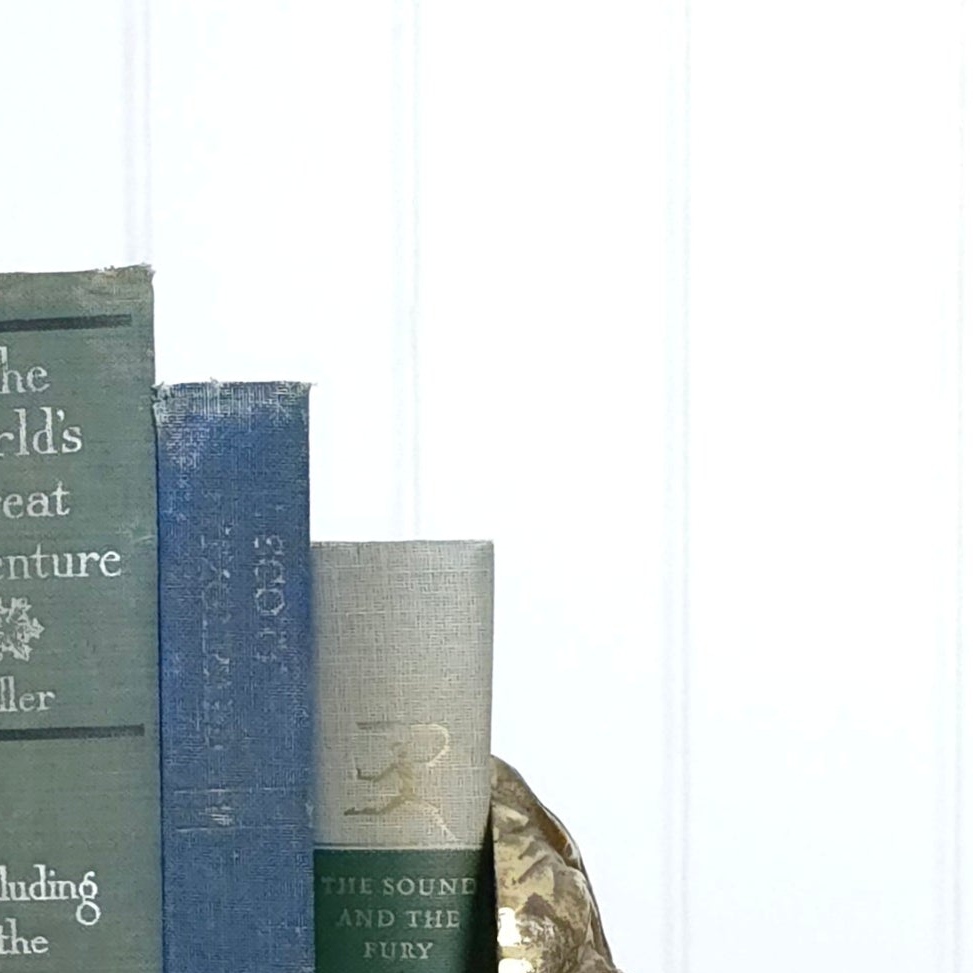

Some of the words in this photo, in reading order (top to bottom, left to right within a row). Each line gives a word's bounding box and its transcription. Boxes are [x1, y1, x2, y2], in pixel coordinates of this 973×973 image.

[322, 876, 373, 896] THE
[336, 908, 395, 928] AND
[406, 909, 461, 929] THE
[363, 942, 434, 960] FURY
